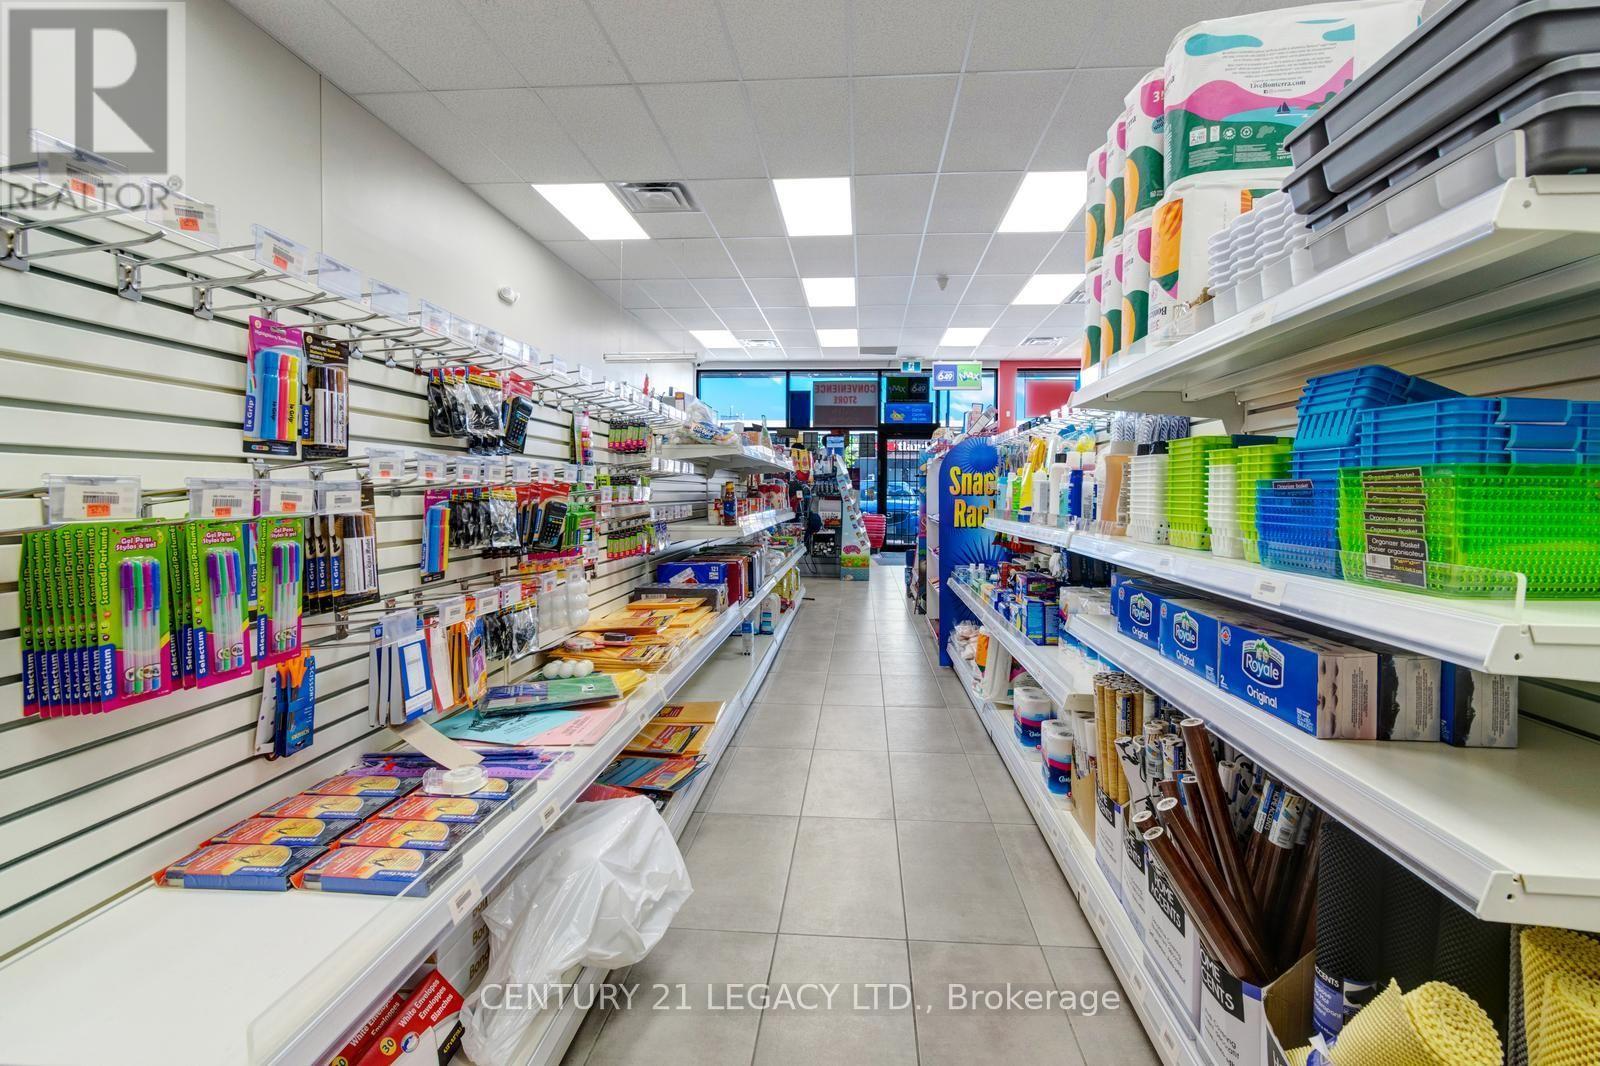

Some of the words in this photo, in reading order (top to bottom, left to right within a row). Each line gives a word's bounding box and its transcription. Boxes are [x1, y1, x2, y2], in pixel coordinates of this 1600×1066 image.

[247, 399, 256, 419] Grip
[949, 466, 1000, 496] Snac
[953, 498, 996, 528] Rac
[120, 537, 134, 545] Gel
[1368, 544, 1386, 553] Panier
[1371, 537, 1399, 547] Organizer
[1400, 540, 1420, 549] Basket
[1131, 603, 1150, 621] Royale
[1175, 623, 1196, 644] Royale
[198, 631, 206, 674] Selectum
[1175, 649, 1195, 667] Original
[27, 653, 35, 700] Selectum
[103, 648, 113, 696] Selectum
[1245, 653, 1280, 681] Royale
[1246, 684, 1278, 709] Original
[1200, 948, 1221, 984] OME
[1315, 964, 1340, 988] CCENTS
[1200, 966, 1235, 1011] CENTS
[398, 1007, 417, 1028] White
[414, 979, 440, 1009] Envelopes
[418, 985, 447, 1020] Enveloppes
[430, 993, 454, 1022] Blanches
[350, 1025, 369, 1047] White
[381, 1039, 395, 1054] 30
